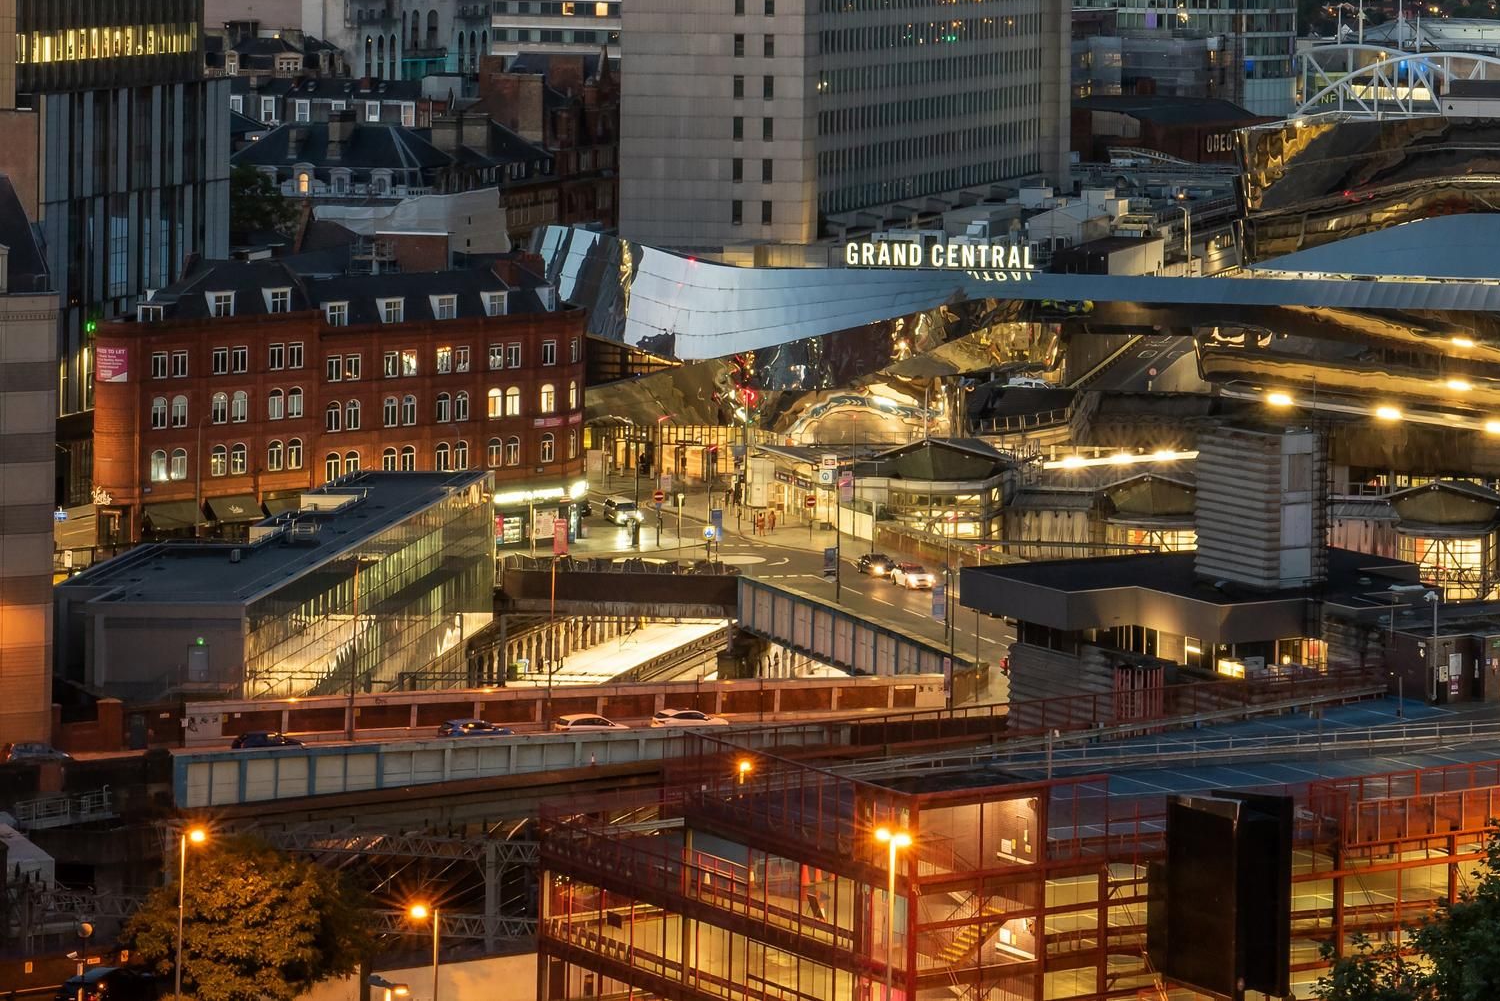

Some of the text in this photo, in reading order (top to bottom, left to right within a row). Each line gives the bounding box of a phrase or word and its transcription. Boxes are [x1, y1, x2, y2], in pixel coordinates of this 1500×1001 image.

[1206, 133, 1236, 152] ODEO
[846, 242, 1035, 269] GRAND CENTRAL
